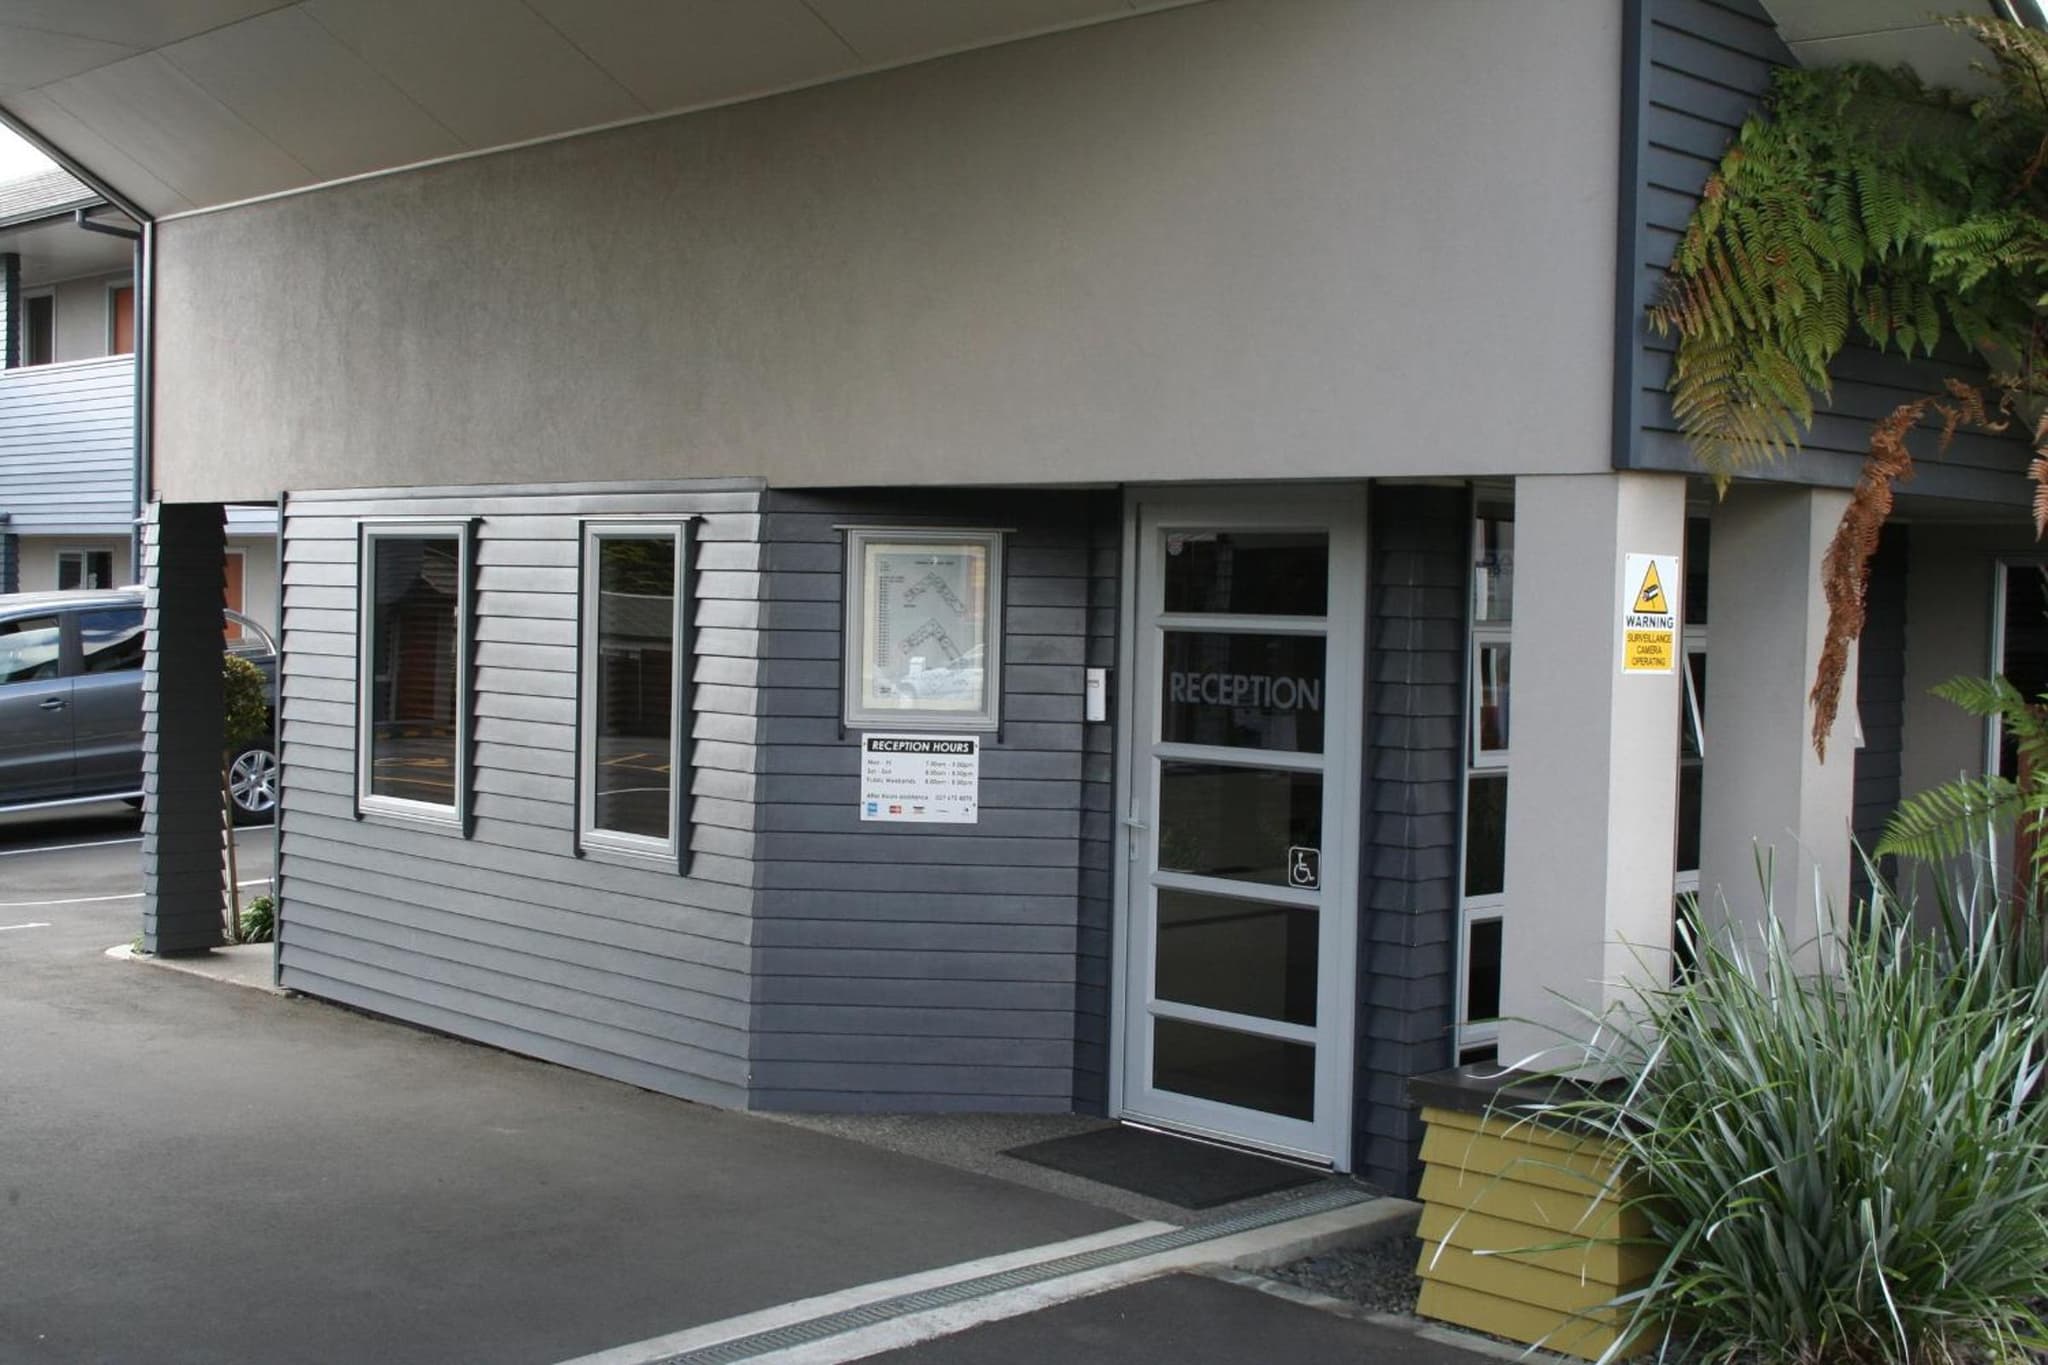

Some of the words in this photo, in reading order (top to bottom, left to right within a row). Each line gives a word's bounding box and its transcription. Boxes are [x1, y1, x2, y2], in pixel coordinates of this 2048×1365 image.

[1626, 615, 1674, 629] WARNING
[1627, 633, 1672, 644] SURVEILLANCE
[1636, 645, 1662, 655] CAMERA
[1631, 657, 1666, 667] OPERATING
[1170, 672, 1320, 711] RECEPTION
[872, 740, 930, 752] RECEPTION
[932, 742, 969, 753] HOURS
